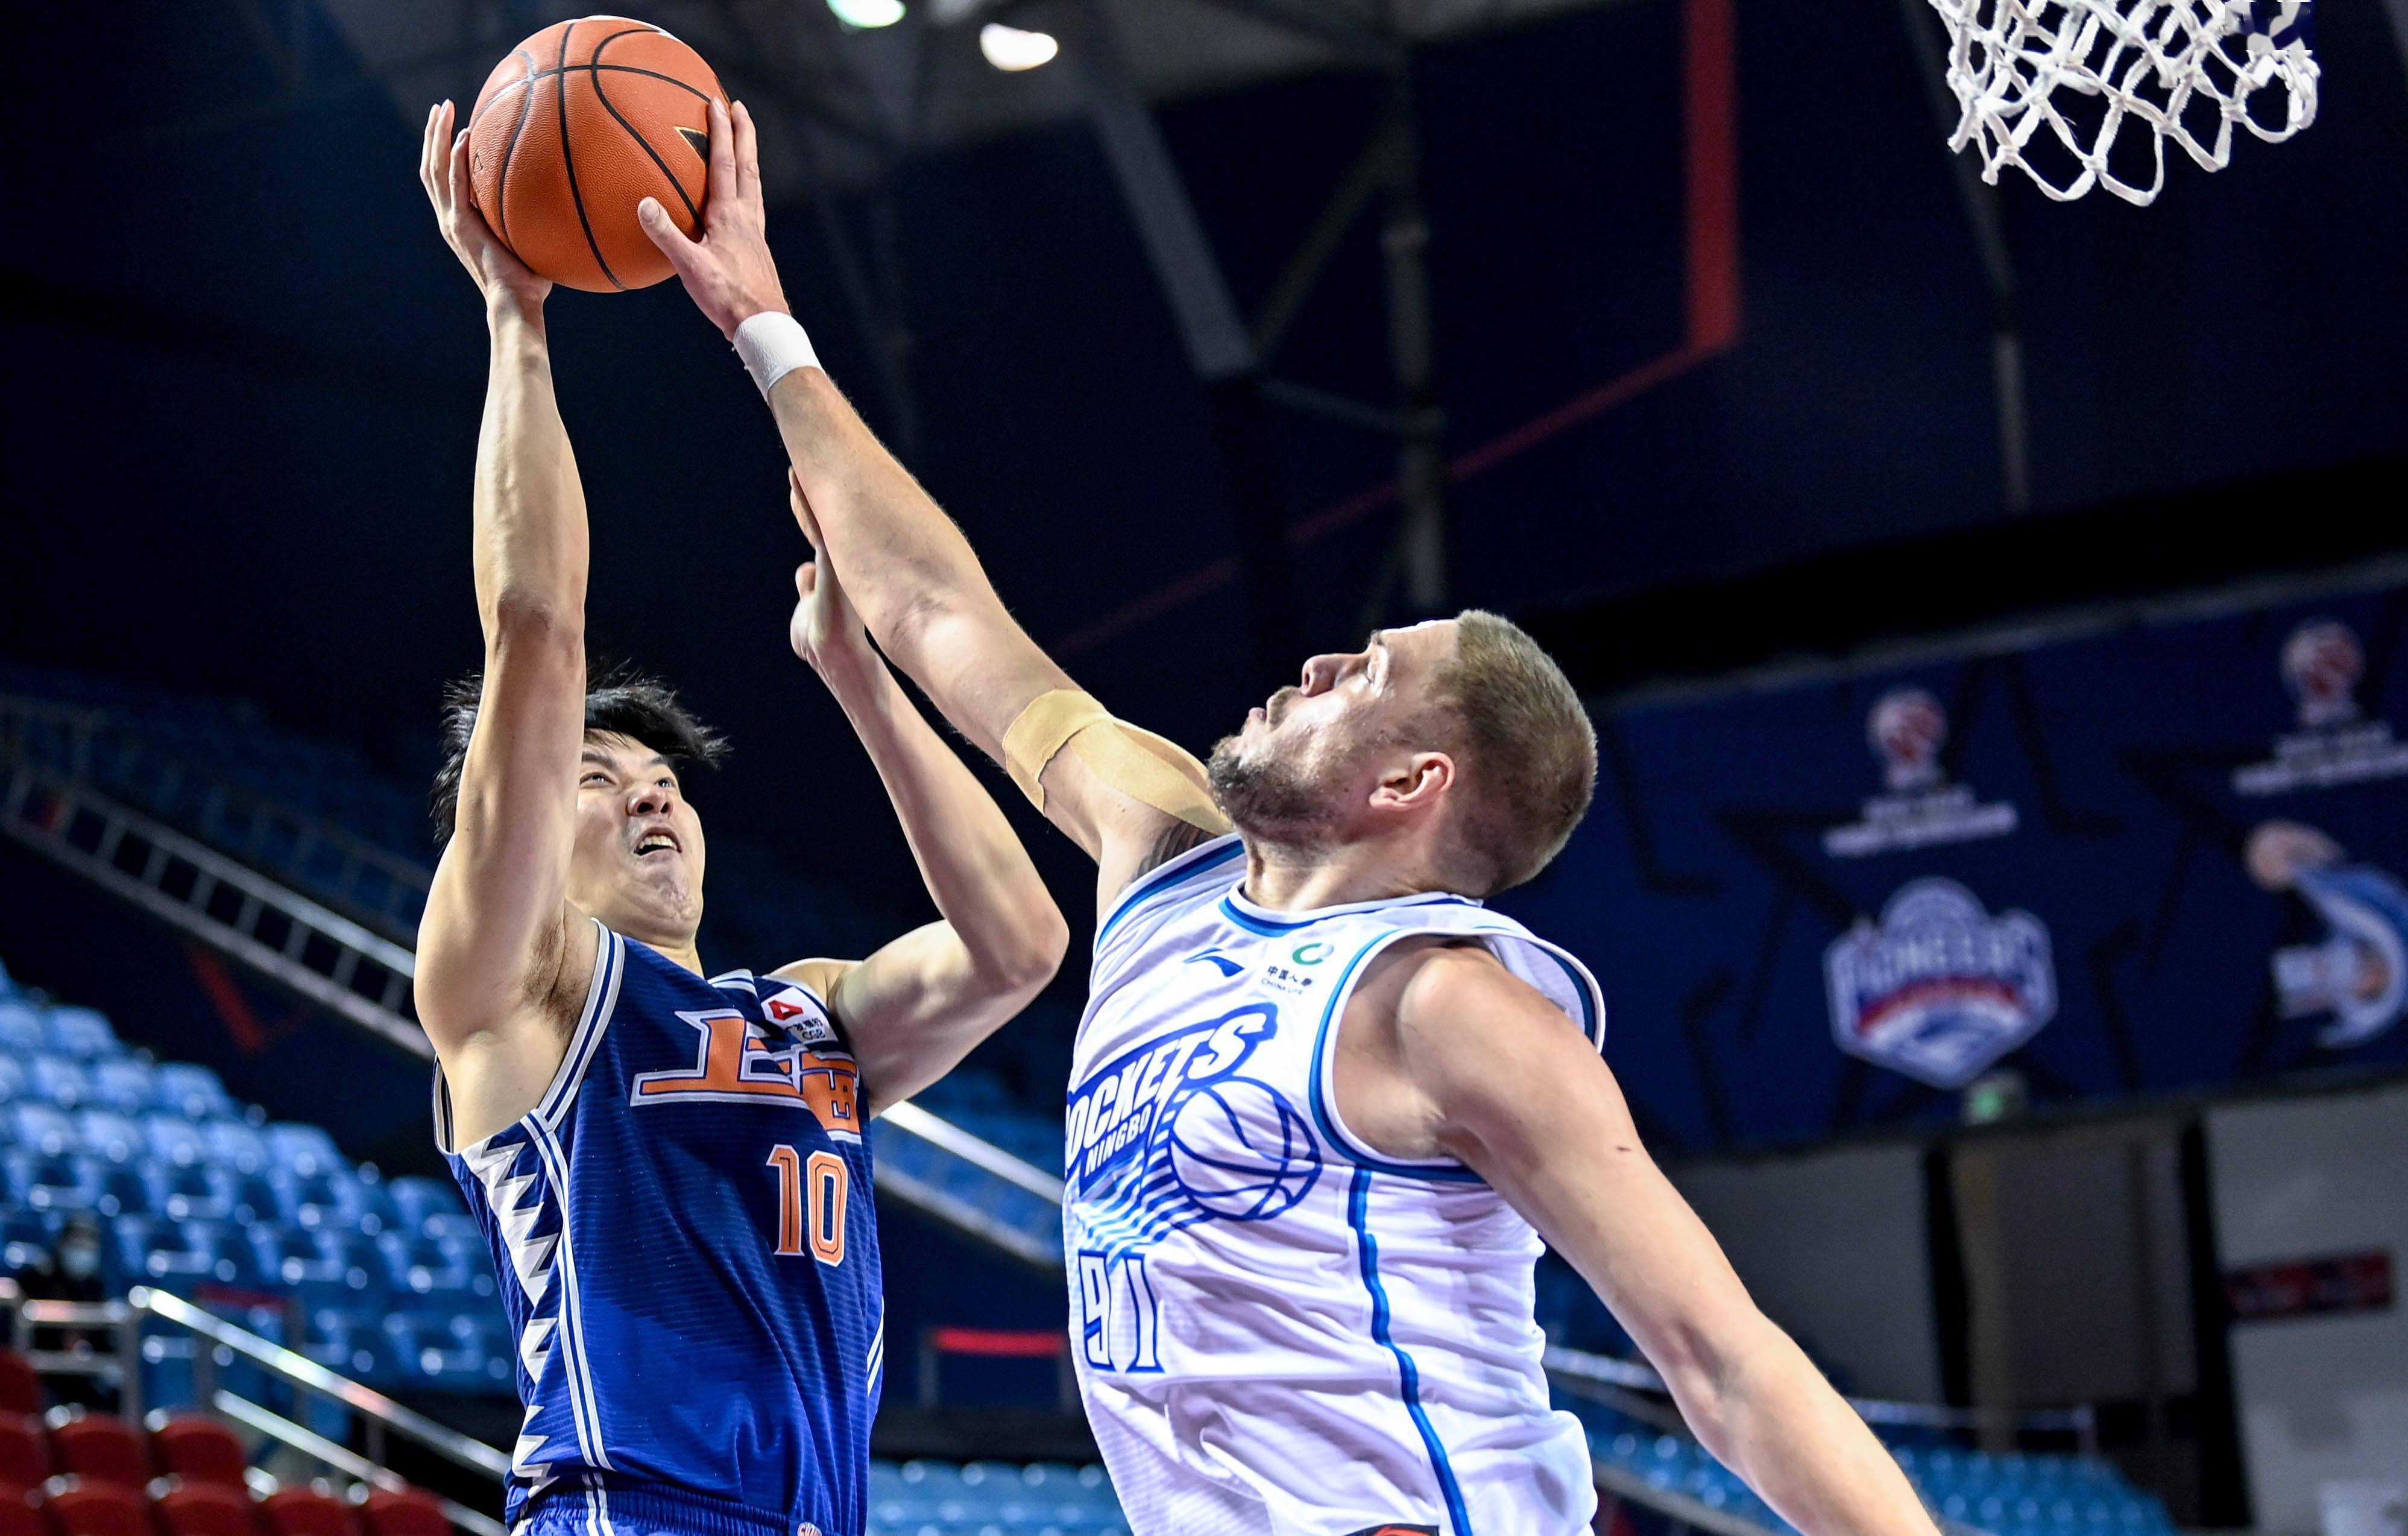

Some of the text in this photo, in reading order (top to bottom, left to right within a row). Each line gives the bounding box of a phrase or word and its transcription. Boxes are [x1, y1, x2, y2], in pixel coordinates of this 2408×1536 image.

[1065, 1013, 1266, 1171] OCKETS
[1085, 1104, 1152, 1178] NINGBO
[766, 1143, 848, 1267] 10
[1078, 1248, 1165, 1373] 91
